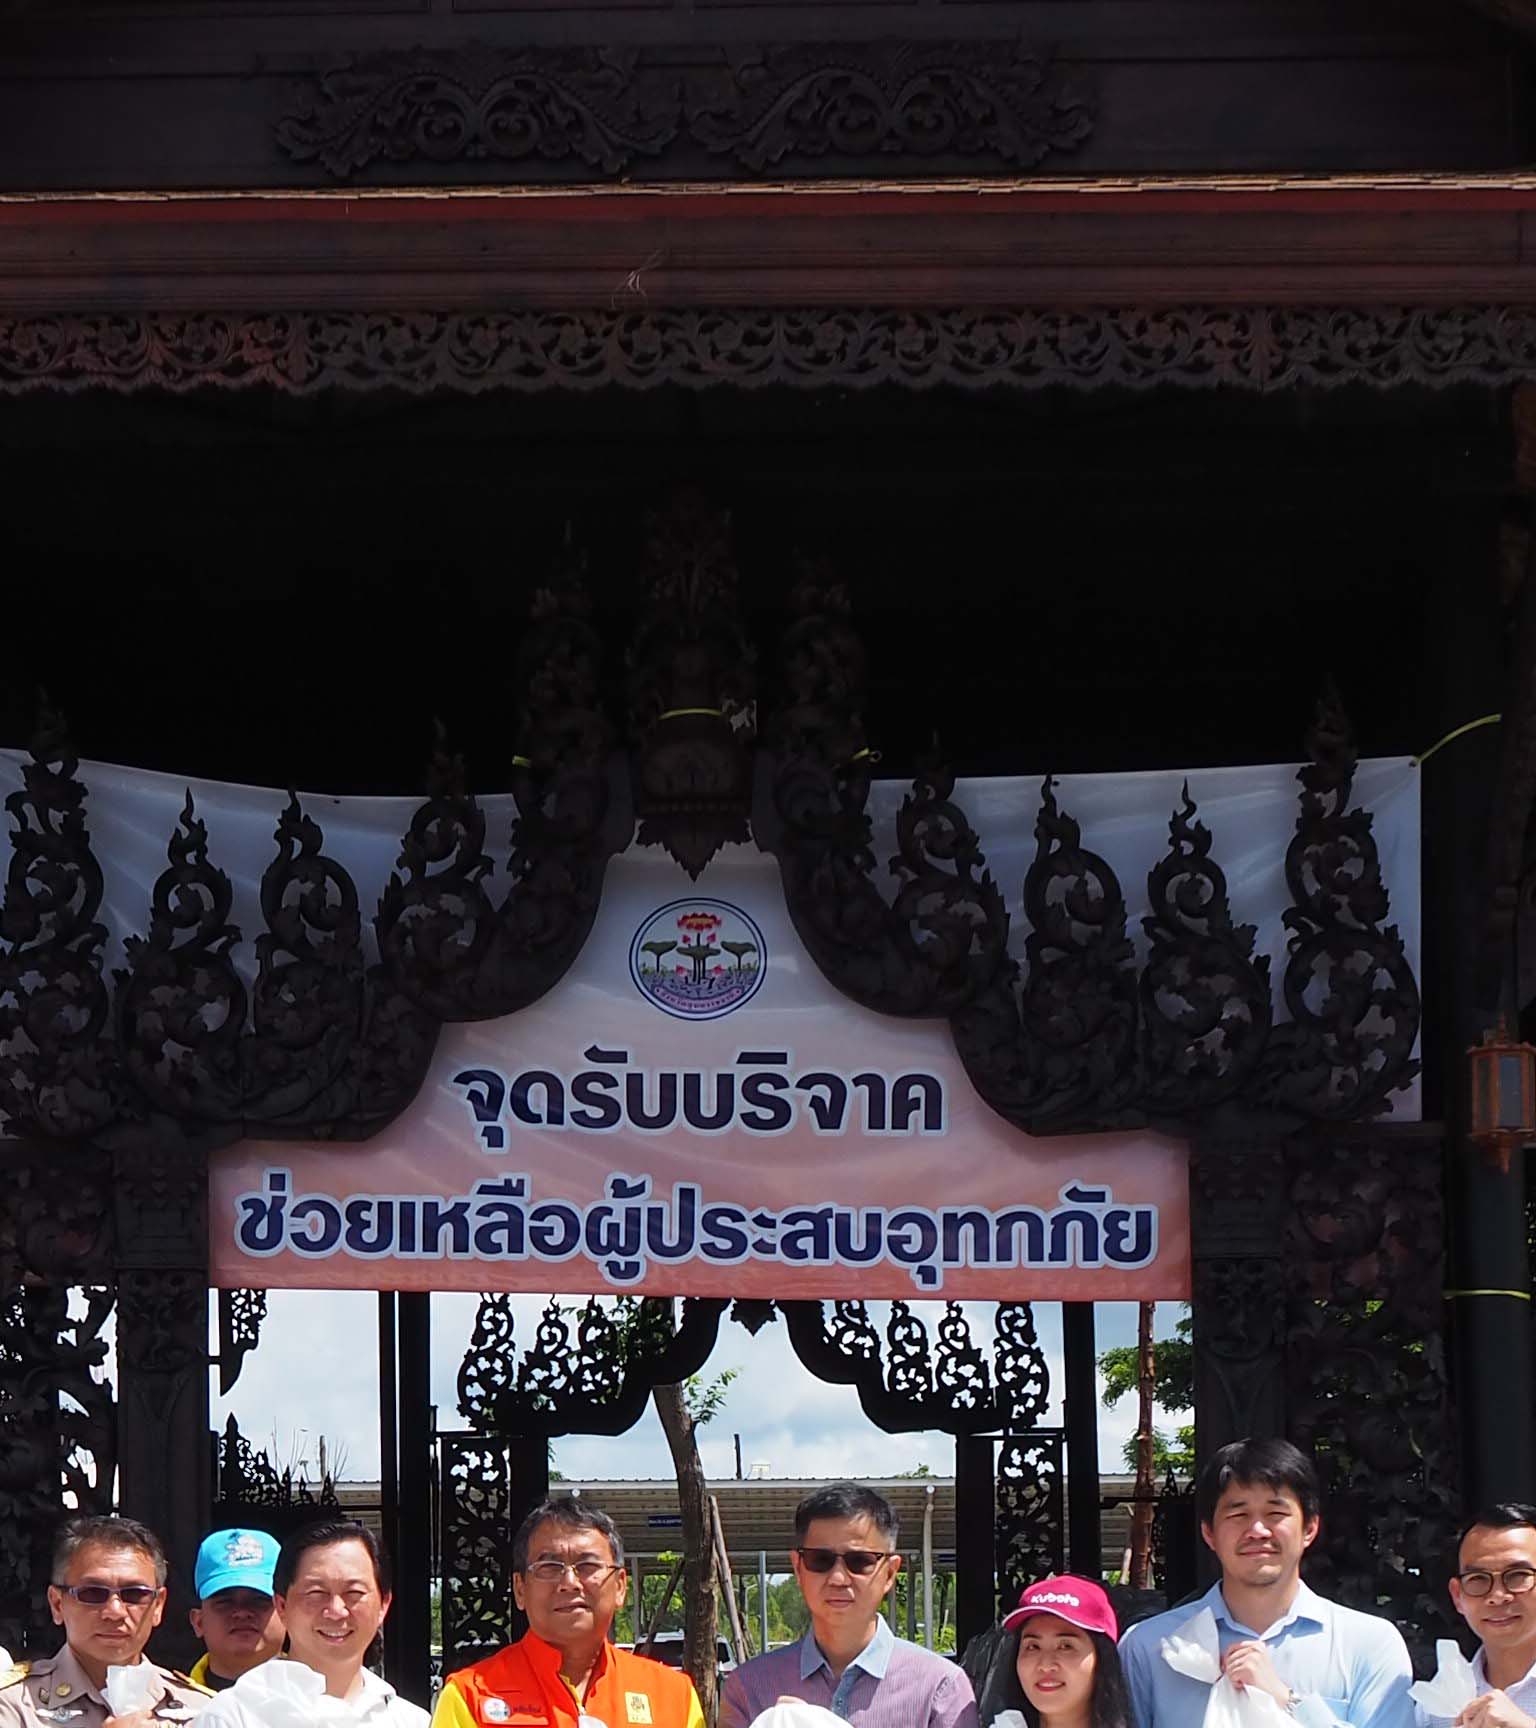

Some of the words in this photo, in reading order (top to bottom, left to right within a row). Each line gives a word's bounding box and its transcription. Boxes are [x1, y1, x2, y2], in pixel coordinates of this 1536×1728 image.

[452, 1045, 943, 1149] จุดรับบริจาค
[240, 1172, 1153, 1286] ช่วยเหลือผู้ประสบอุทกภัย
